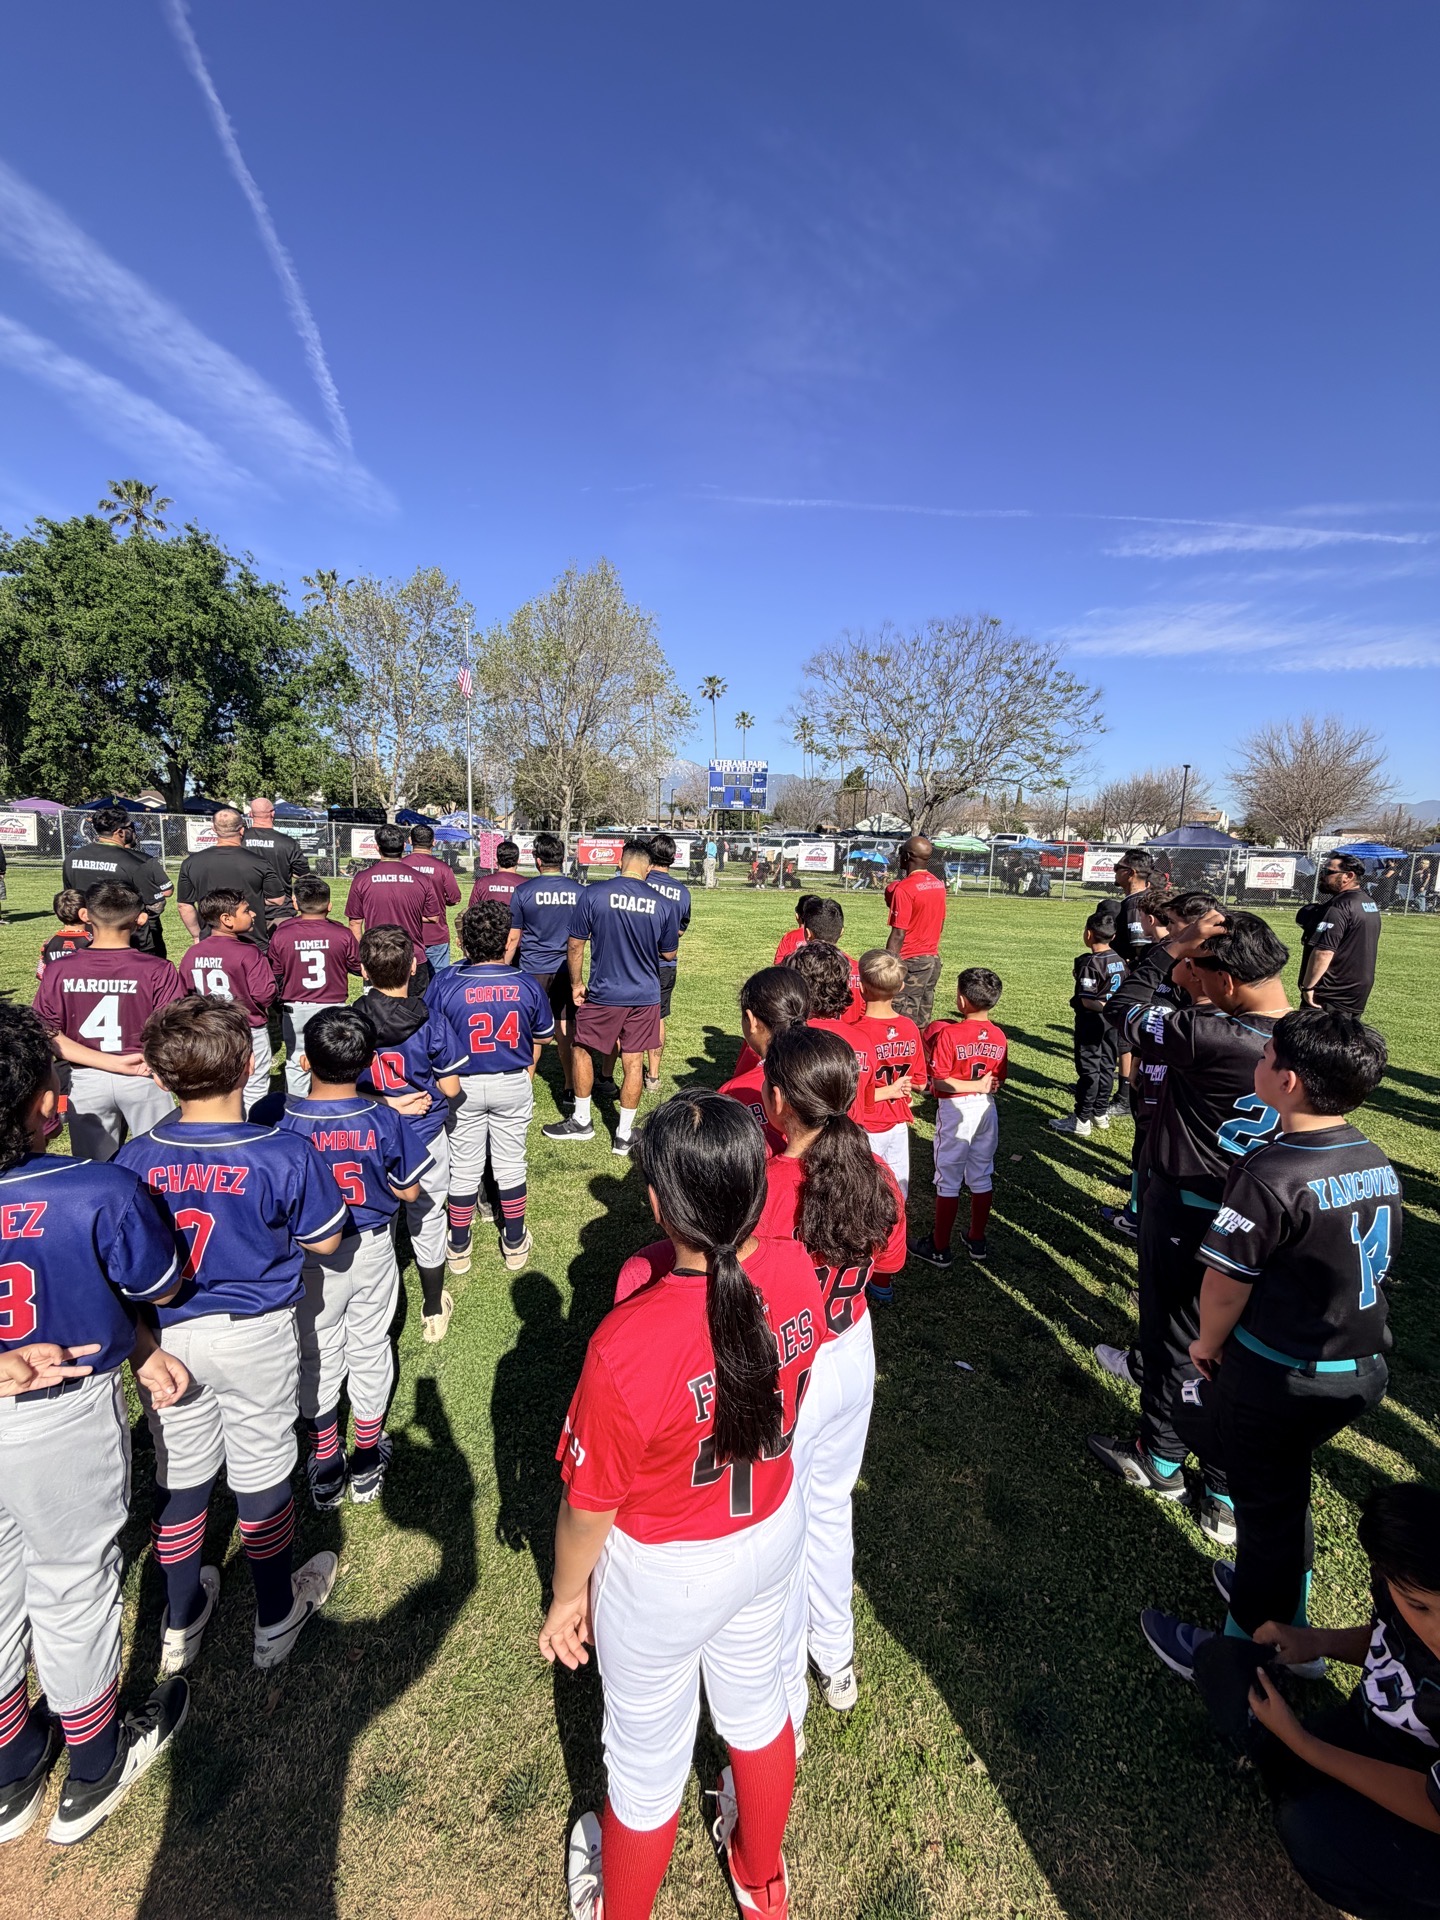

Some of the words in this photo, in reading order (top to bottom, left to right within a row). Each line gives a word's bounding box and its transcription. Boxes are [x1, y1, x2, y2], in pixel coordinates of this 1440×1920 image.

[710, 760, 747, 768] VETERANS
[748, 761, 768, 769] PARK
[72, 859, 118, 873] HARRISON
[371, 874, 397, 883] COACH
[398, 874, 414, 883] SAL
[489, 885, 508, 893] COACH
[535, 891, 577, 905] COACH
[647, 882, 681, 902] OACH
[610, 893, 656, 915] COACH
[294, 940, 330, 951] LOMELI
[195, 957, 223, 969] MARIZ
[300, 951, 327, 990] 3
[63, 979, 138, 994] MARQUEZ
[191, 969, 233, 1001] 18
[465, 985, 520, 1004] CORTEZ
[79, 995, 123, 1052] 4
[468, 1010, 521, 1054] 24
[956, 1042, 1006, 1060] ROMERO
[370, 1050, 408, 1092] 10
[1216, 1092, 1284, 1156] 2
[148, 1163, 250, 1196] CHAVEZ
[326, 1161, 367, 1206] 5
[174, 1208, 216, 1281] 7
[1350, 1205, 1392, 1310] 14
